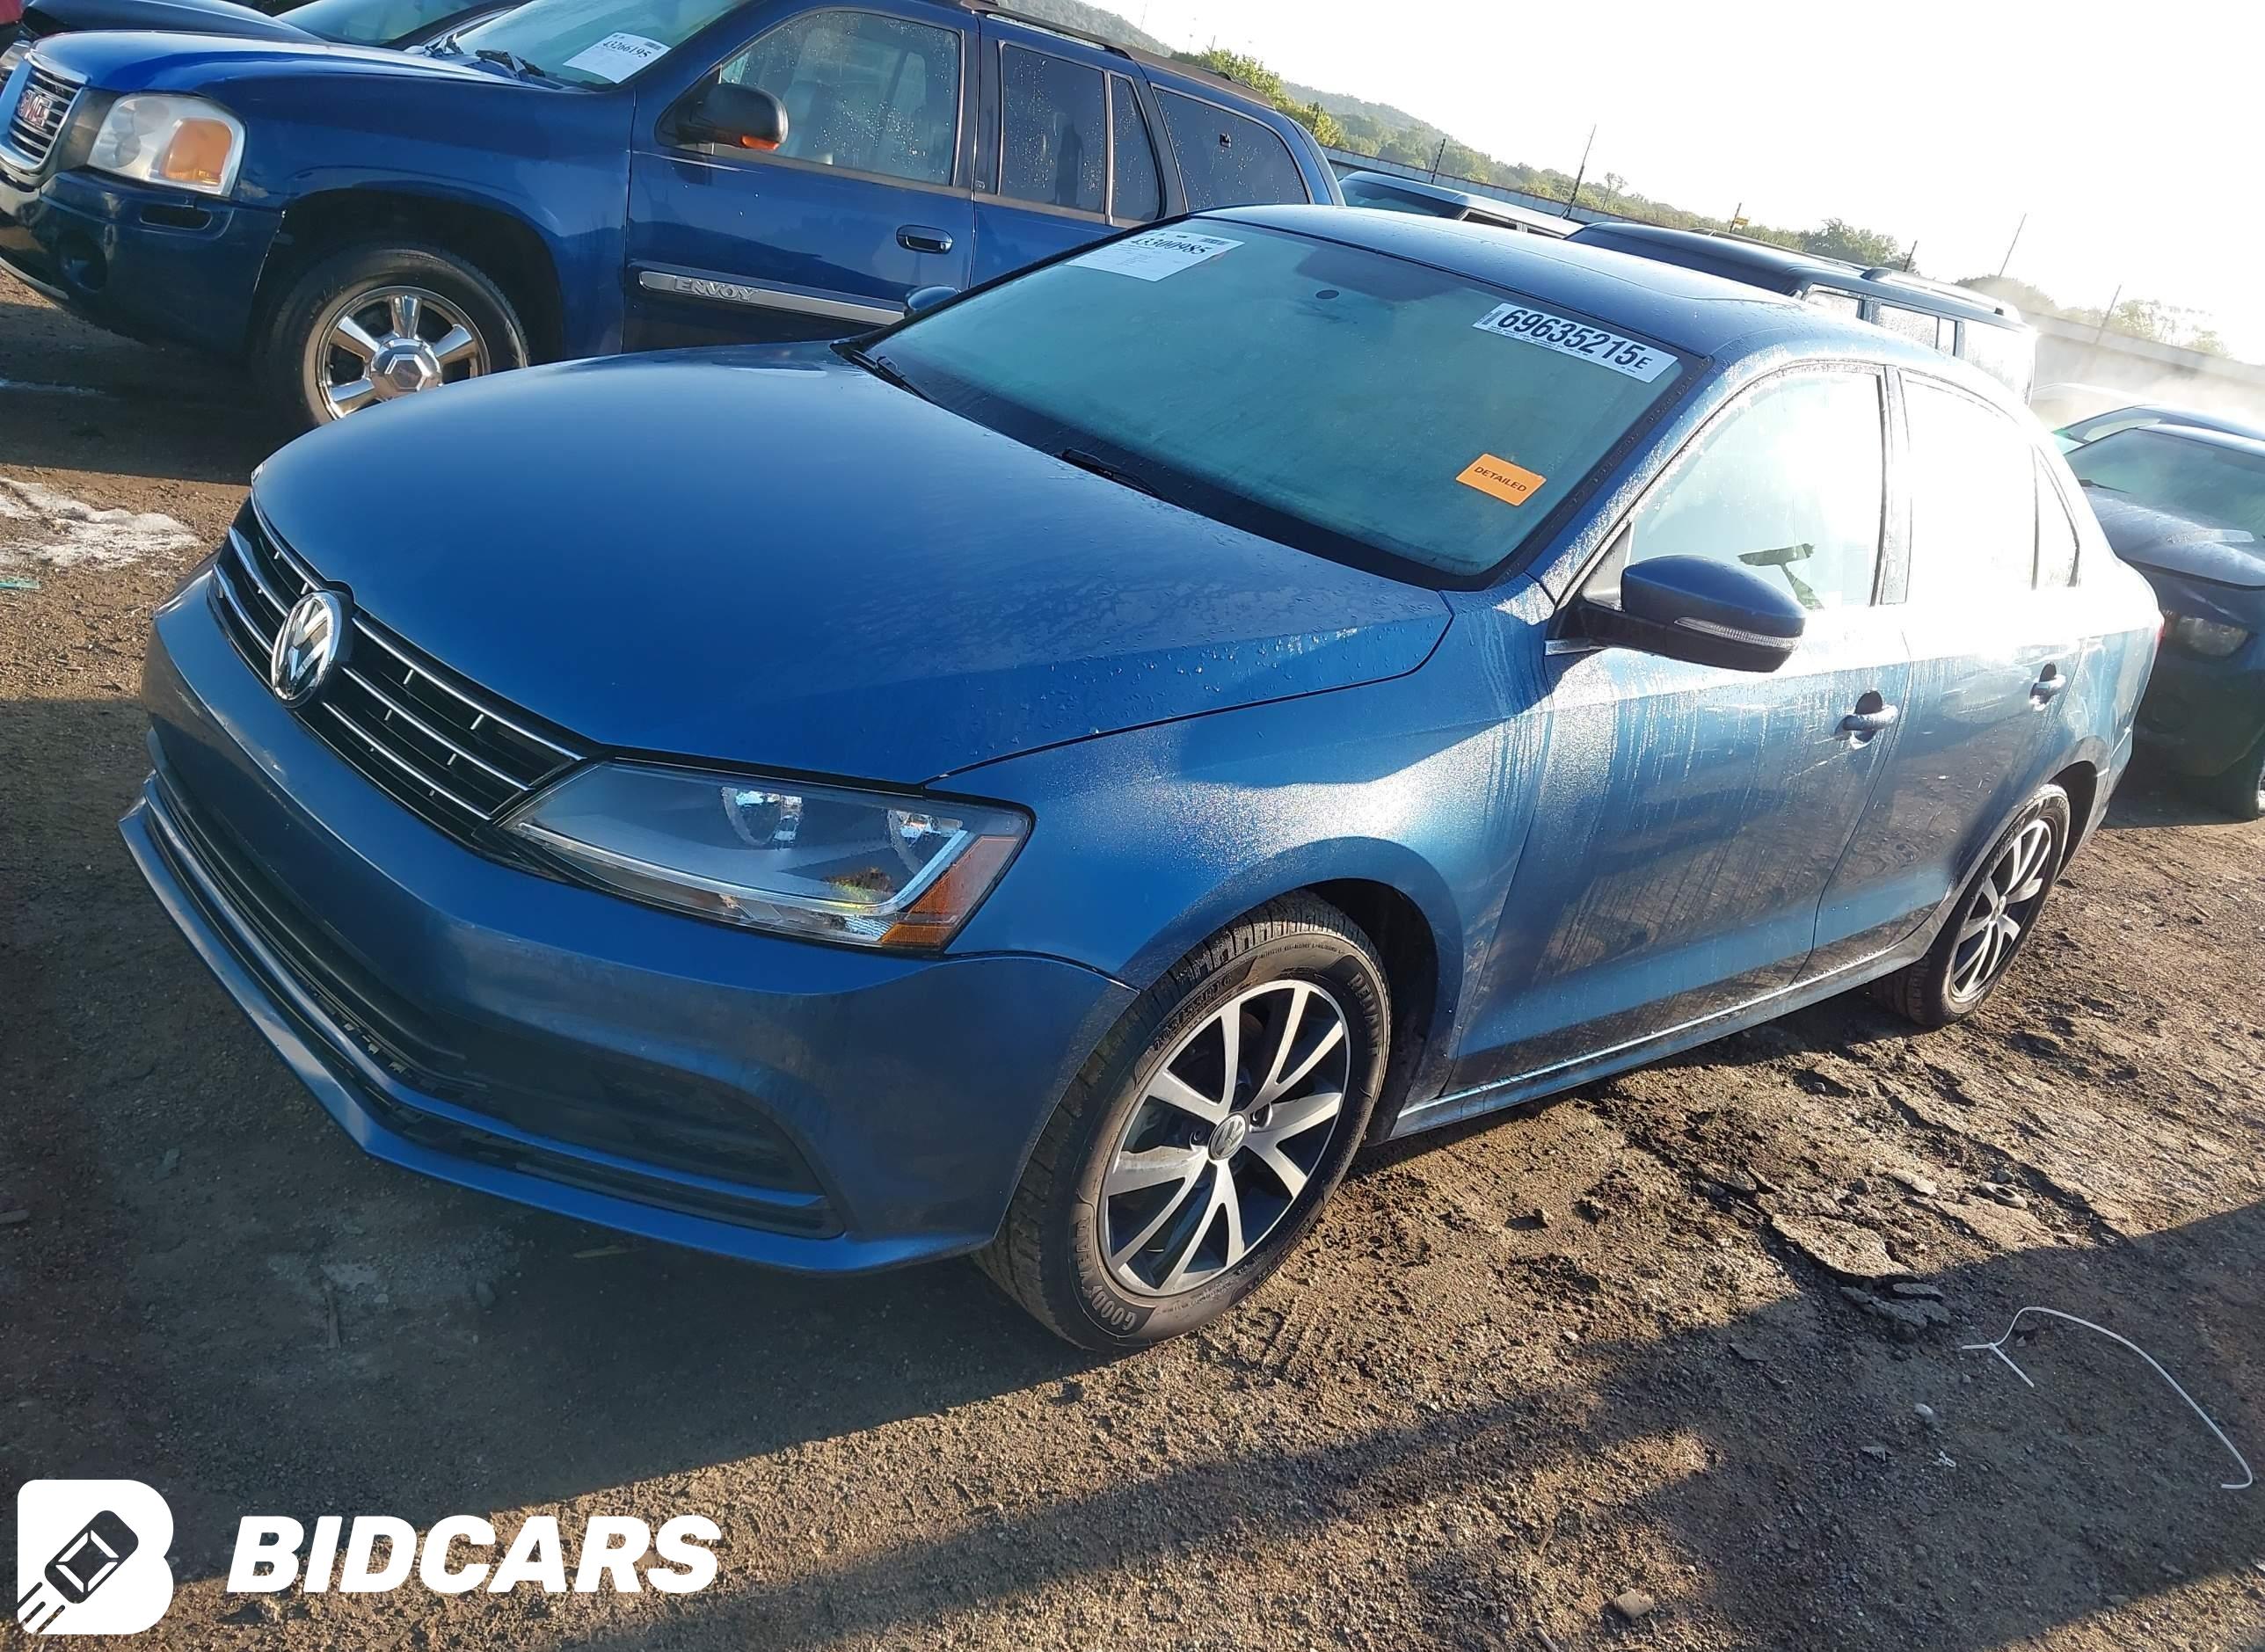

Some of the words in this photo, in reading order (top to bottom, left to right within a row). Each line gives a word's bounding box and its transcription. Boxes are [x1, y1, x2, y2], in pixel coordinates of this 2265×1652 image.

[602, 40, 652, 58] 43266195
[1131, 237, 1213, 255] 43300985
[674, 276, 760, 302] ENVOY
[1497, 309, 1647, 366] 69635215
[1635, 356, 1653, 369] E
[1474, 466, 1527, 492] DETAILED
